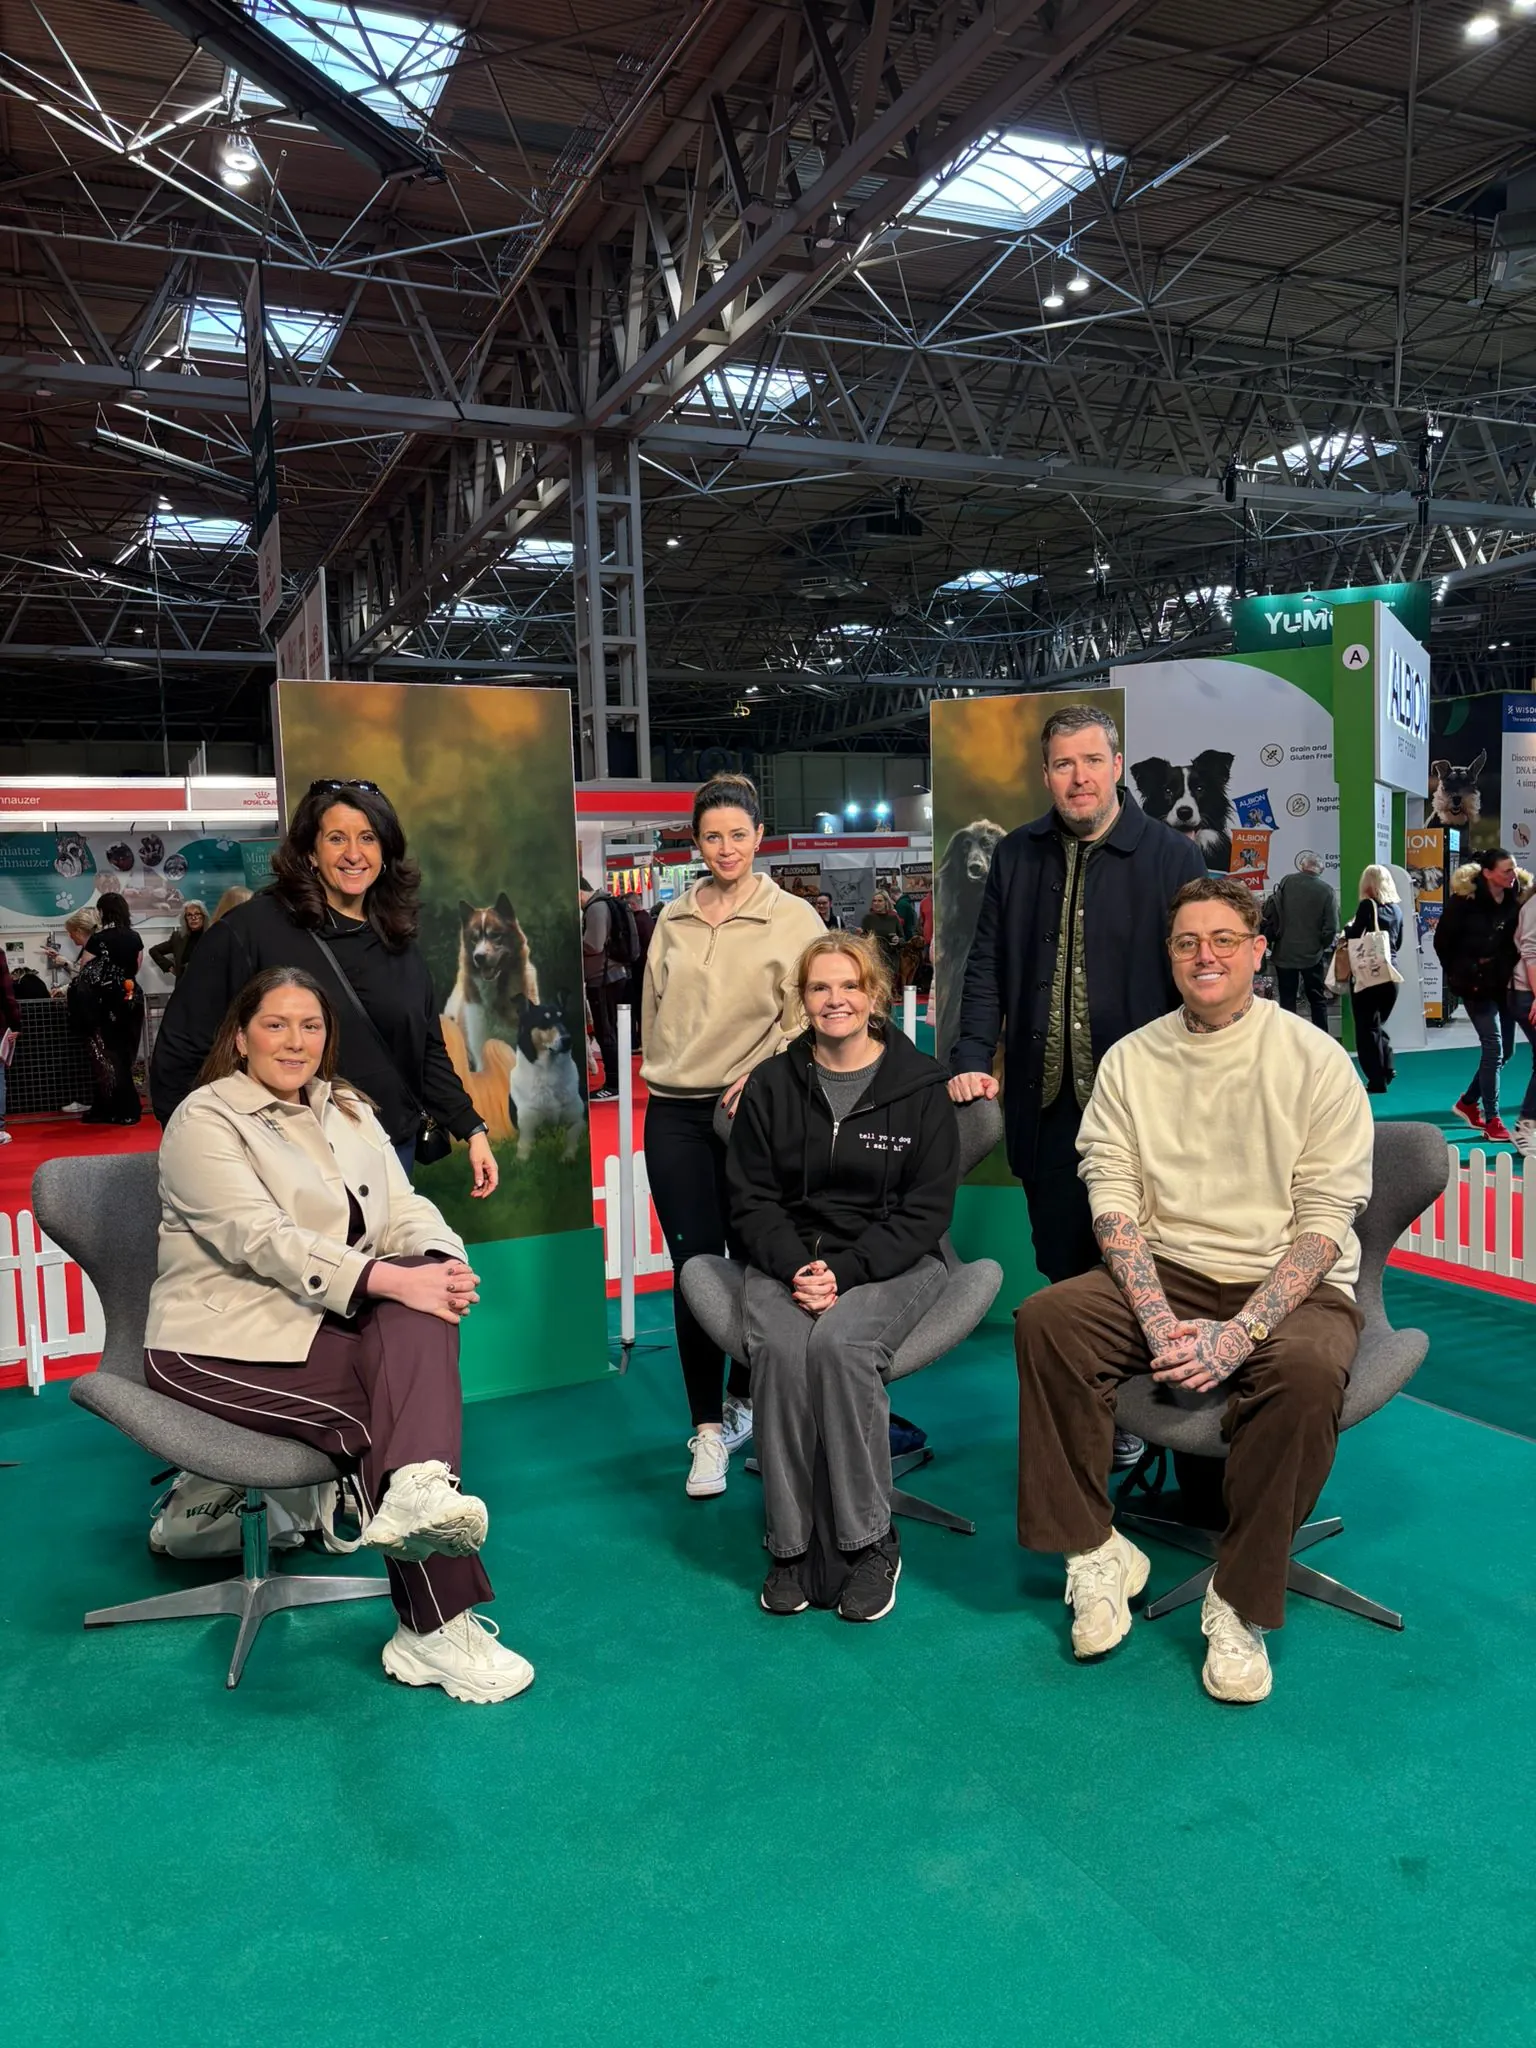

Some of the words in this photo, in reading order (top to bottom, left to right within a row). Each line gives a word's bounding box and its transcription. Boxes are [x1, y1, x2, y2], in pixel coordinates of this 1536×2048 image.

[1349, 650, 1363, 664] A
[1387, 647, 1428, 744] ALBION
[1515, 706, 1536, 714] WISD
[1239, 794, 1266, 808] ALBION
[1236, 834, 1267, 843] ALBION
[1407, 834, 1437, 849] ION
